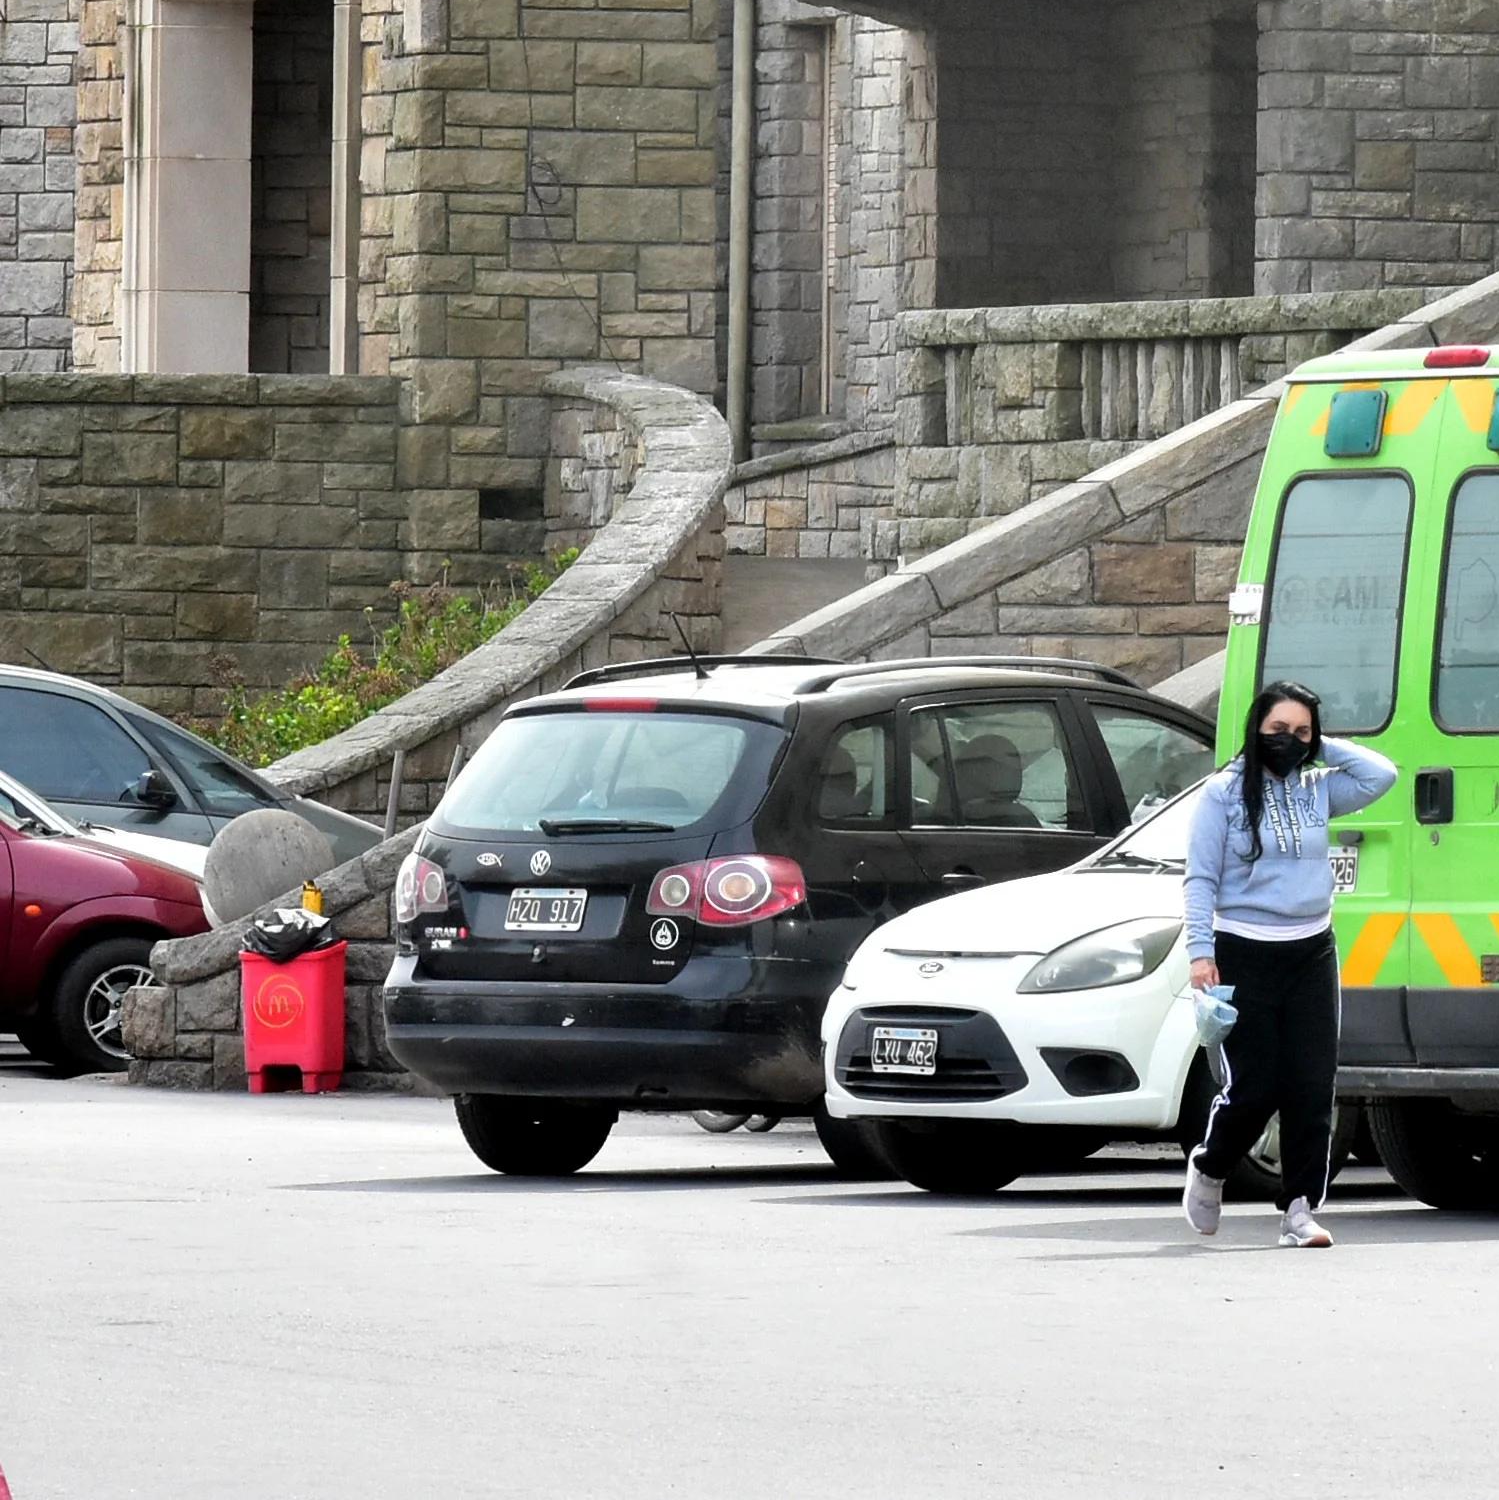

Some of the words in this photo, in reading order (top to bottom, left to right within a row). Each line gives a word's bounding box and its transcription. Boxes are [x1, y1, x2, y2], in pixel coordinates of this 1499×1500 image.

[510, 899, 541, 922] HZQ
[549, 899, 583, 923] 917
[874, 1039, 902, 1064] LYU
[906, 1041, 935, 1066] 462
